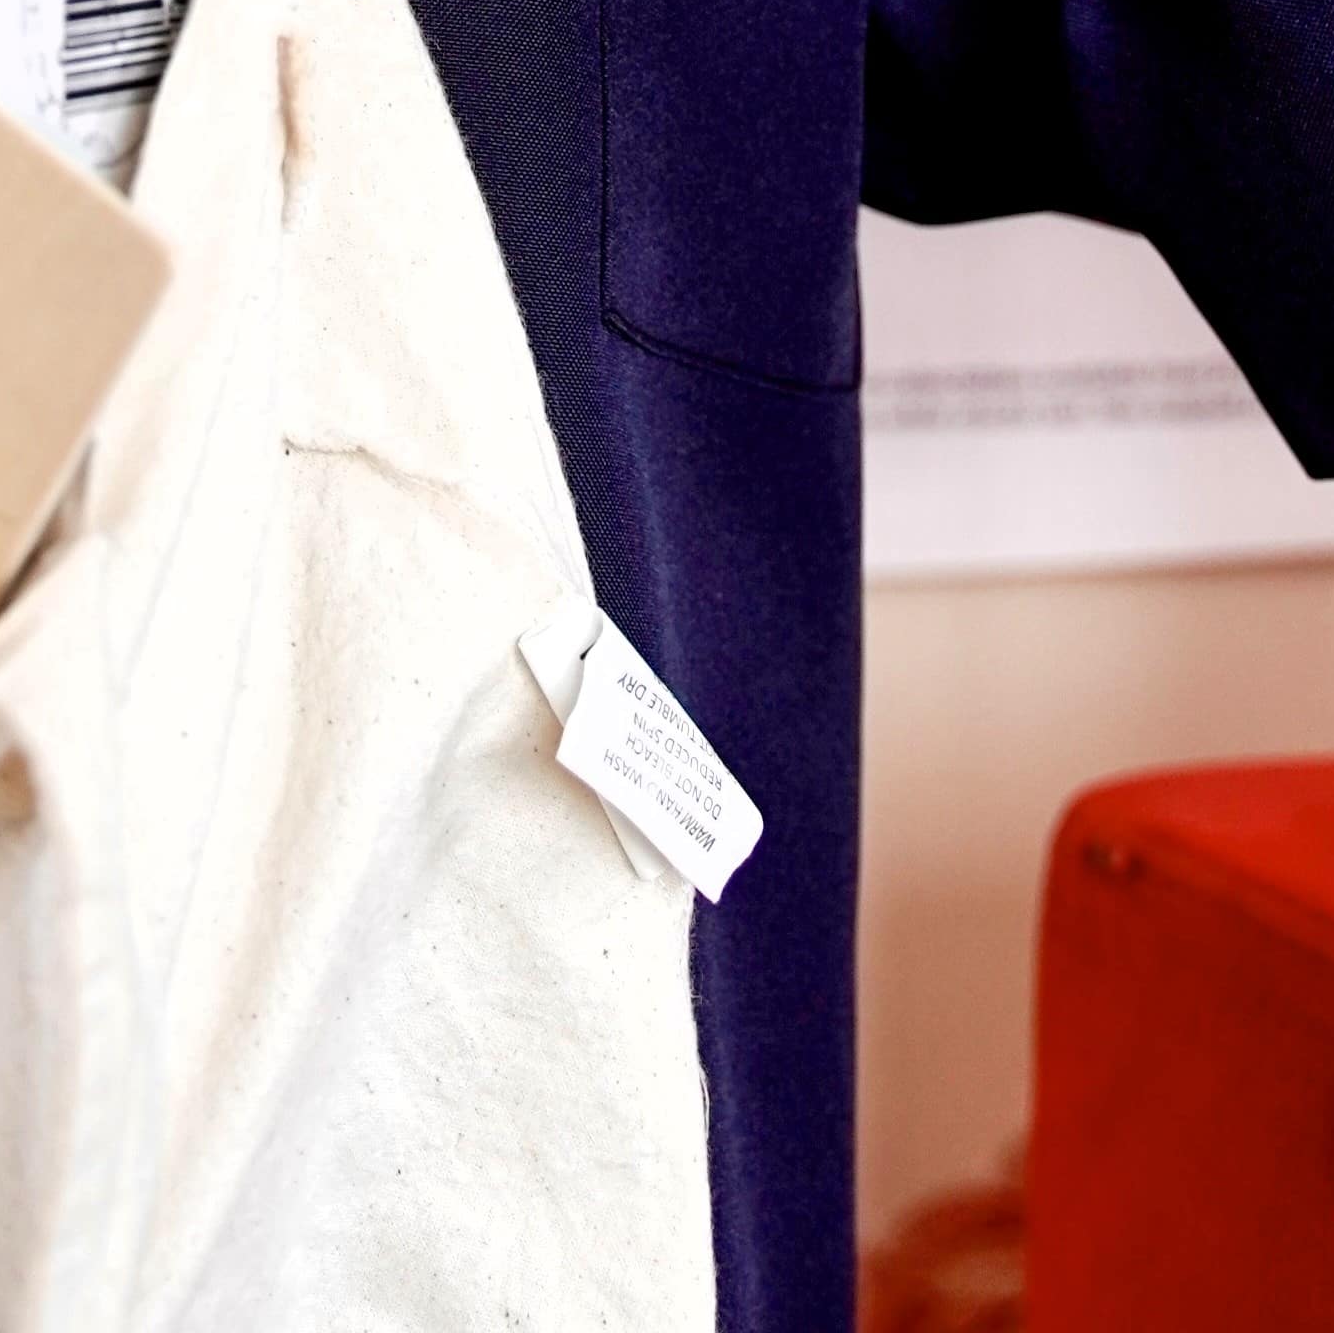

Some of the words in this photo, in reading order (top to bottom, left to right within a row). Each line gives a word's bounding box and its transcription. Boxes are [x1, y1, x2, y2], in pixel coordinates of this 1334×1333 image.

[616, 672, 648, 702] DRY
[633, 712, 664, 745] SPIN
[647, 692, 697, 744] TUMBLE
[603, 748, 643, 790] WASH
[625, 732, 675, 780] BLEACH
[664, 736, 724, 792] REDUCED
[674, 773, 703, 804] NOT
[703, 795, 723, 822] DO
[679, 811, 717, 853] WARM
